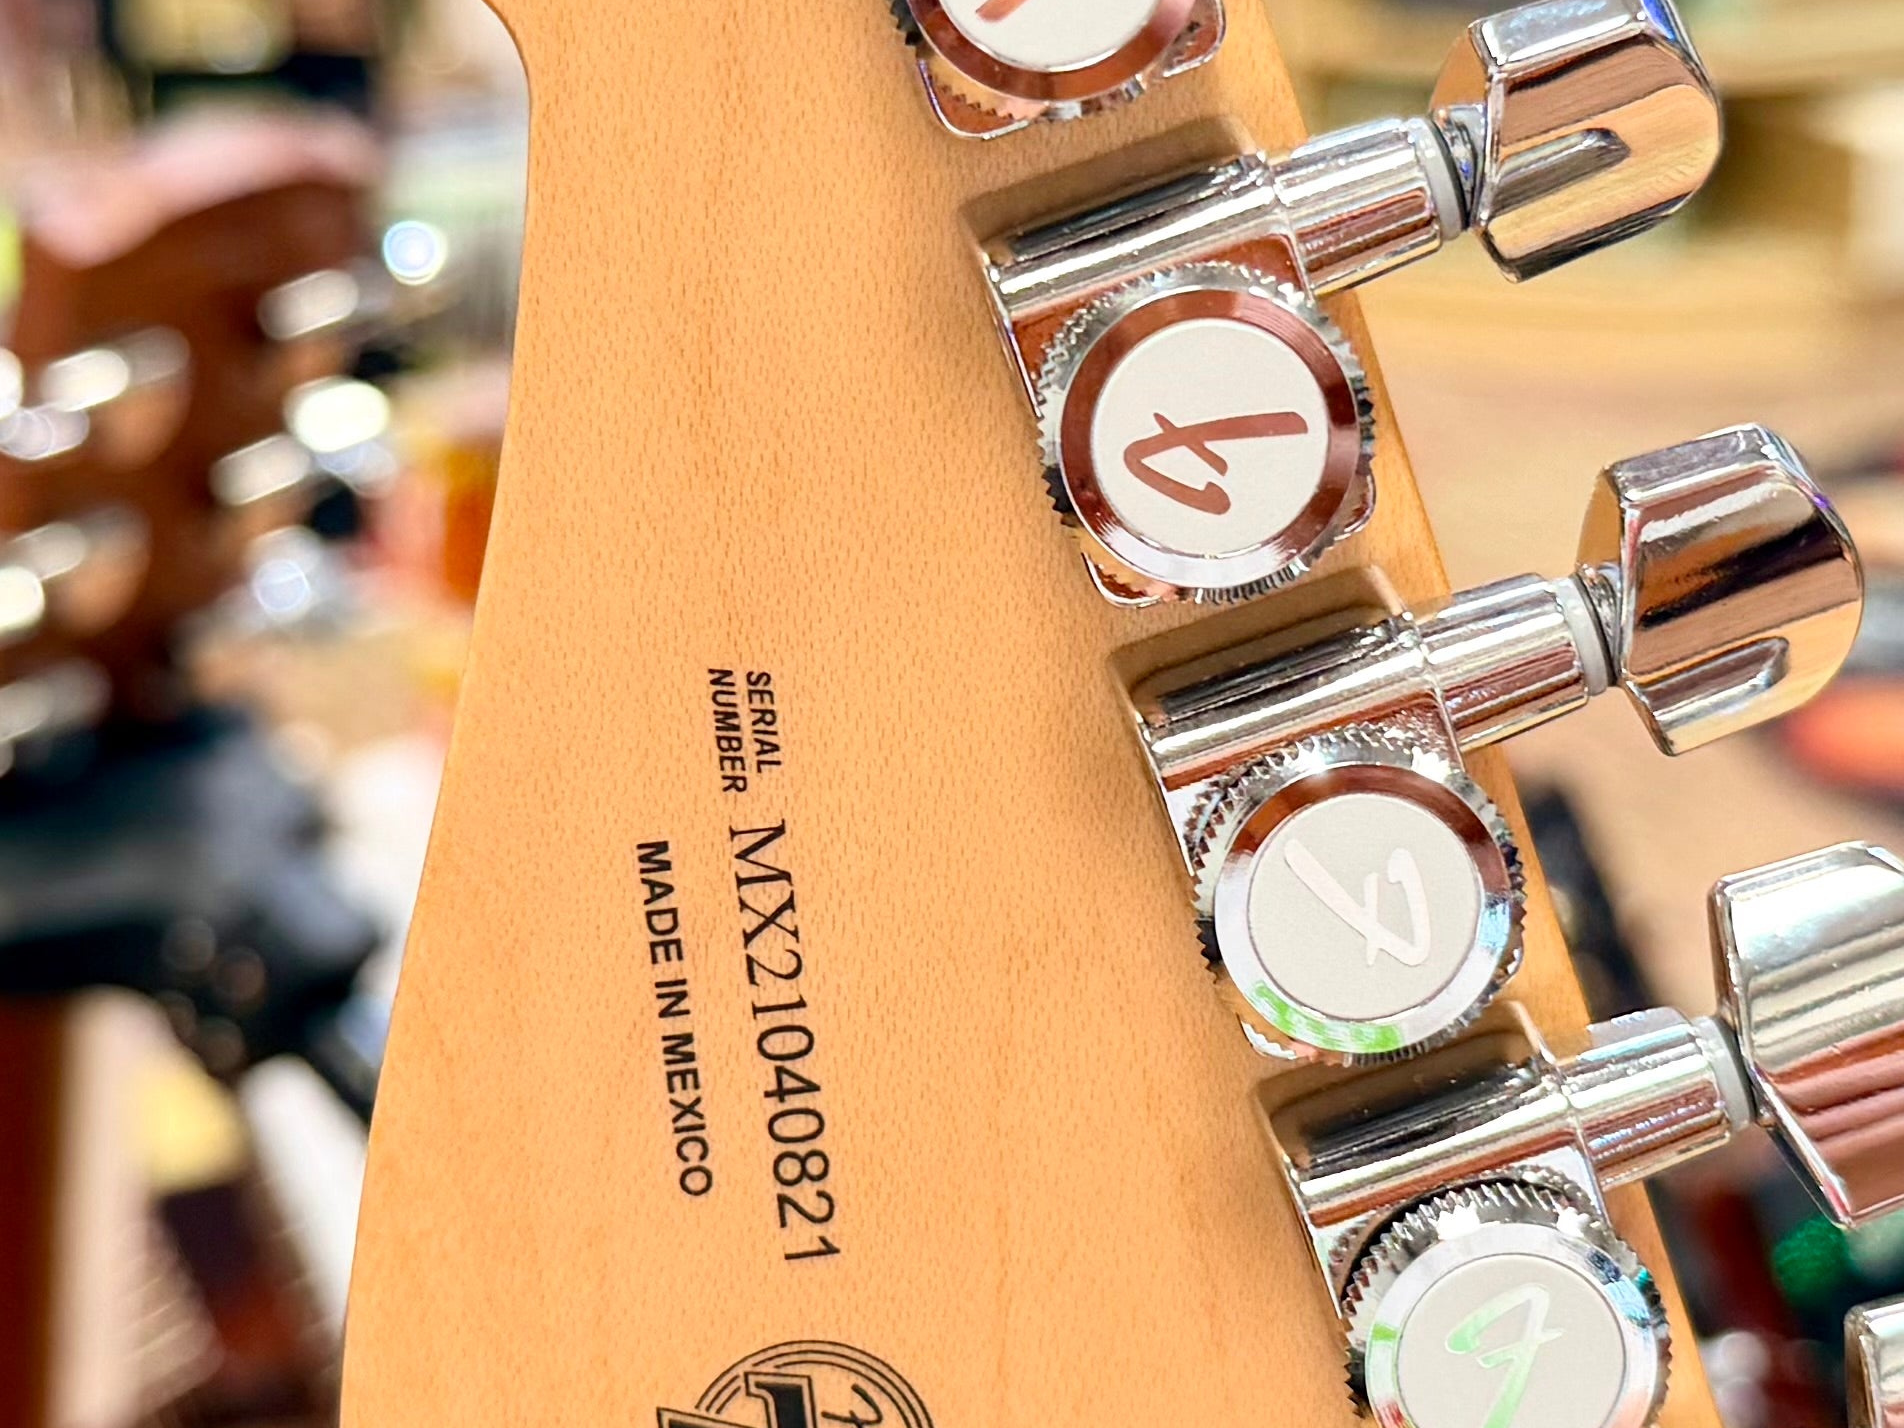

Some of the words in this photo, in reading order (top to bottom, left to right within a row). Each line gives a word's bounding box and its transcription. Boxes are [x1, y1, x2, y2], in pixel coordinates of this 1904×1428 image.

[706, 667, 749, 794] NUMBER
[745, 669, 783, 775] SERIAL
[635, 839, 685, 967] MADE
[653, 977, 692, 1020] IN
[727, 817, 842, 1263] MX21040821
[660, 1031, 714, 1198] MEXICO
